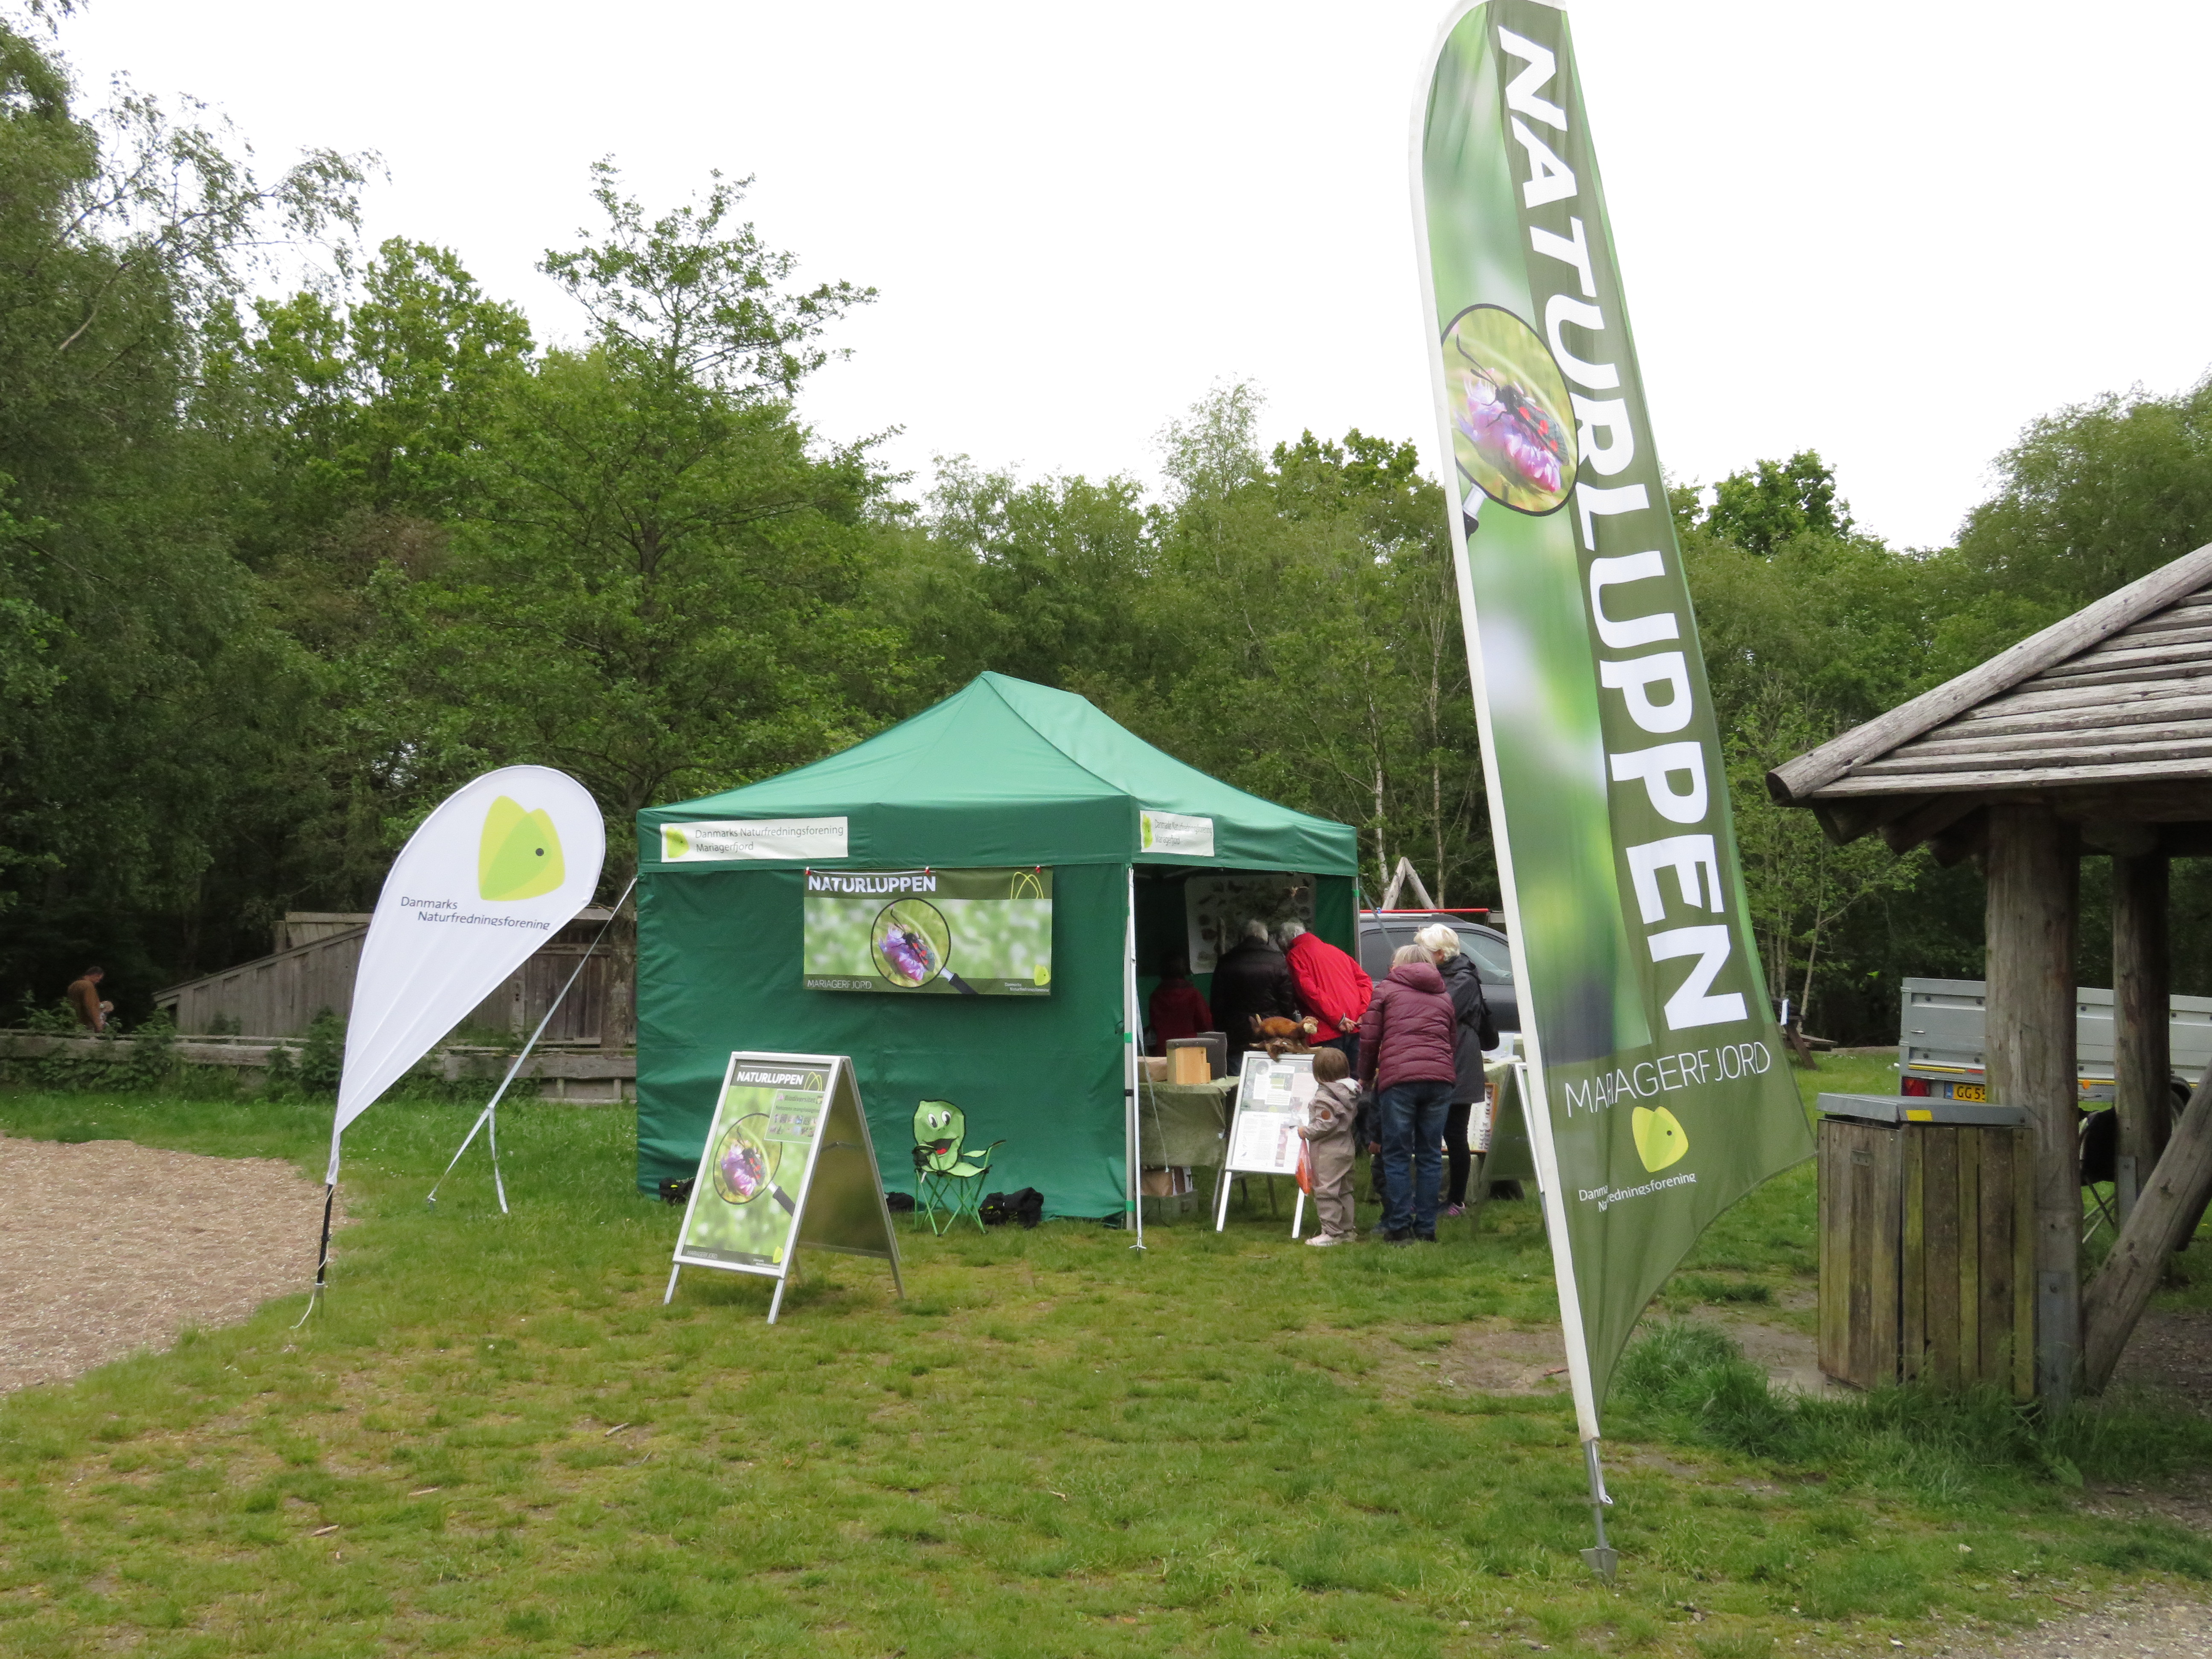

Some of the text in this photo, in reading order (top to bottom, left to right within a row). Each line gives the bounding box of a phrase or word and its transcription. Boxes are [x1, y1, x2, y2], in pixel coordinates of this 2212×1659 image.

[1497, 25, 1749, 1030] NATURLUPPEN
[695, 826, 844, 838] Danmarks Naturfredningsforening
[696, 841, 754, 853] Mariagerfjord
[808, 876, 936, 893] NATURLUPPEN
[401, 896, 458, 909] Danmarks
[418, 911, 550, 930] Naturfredningsforening
[807, 979, 872, 989] MARIAGERFJORD
[737, 1071, 804, 1085] NATURLUPPEN
[1957, 1086, 1971, 1098] GG
